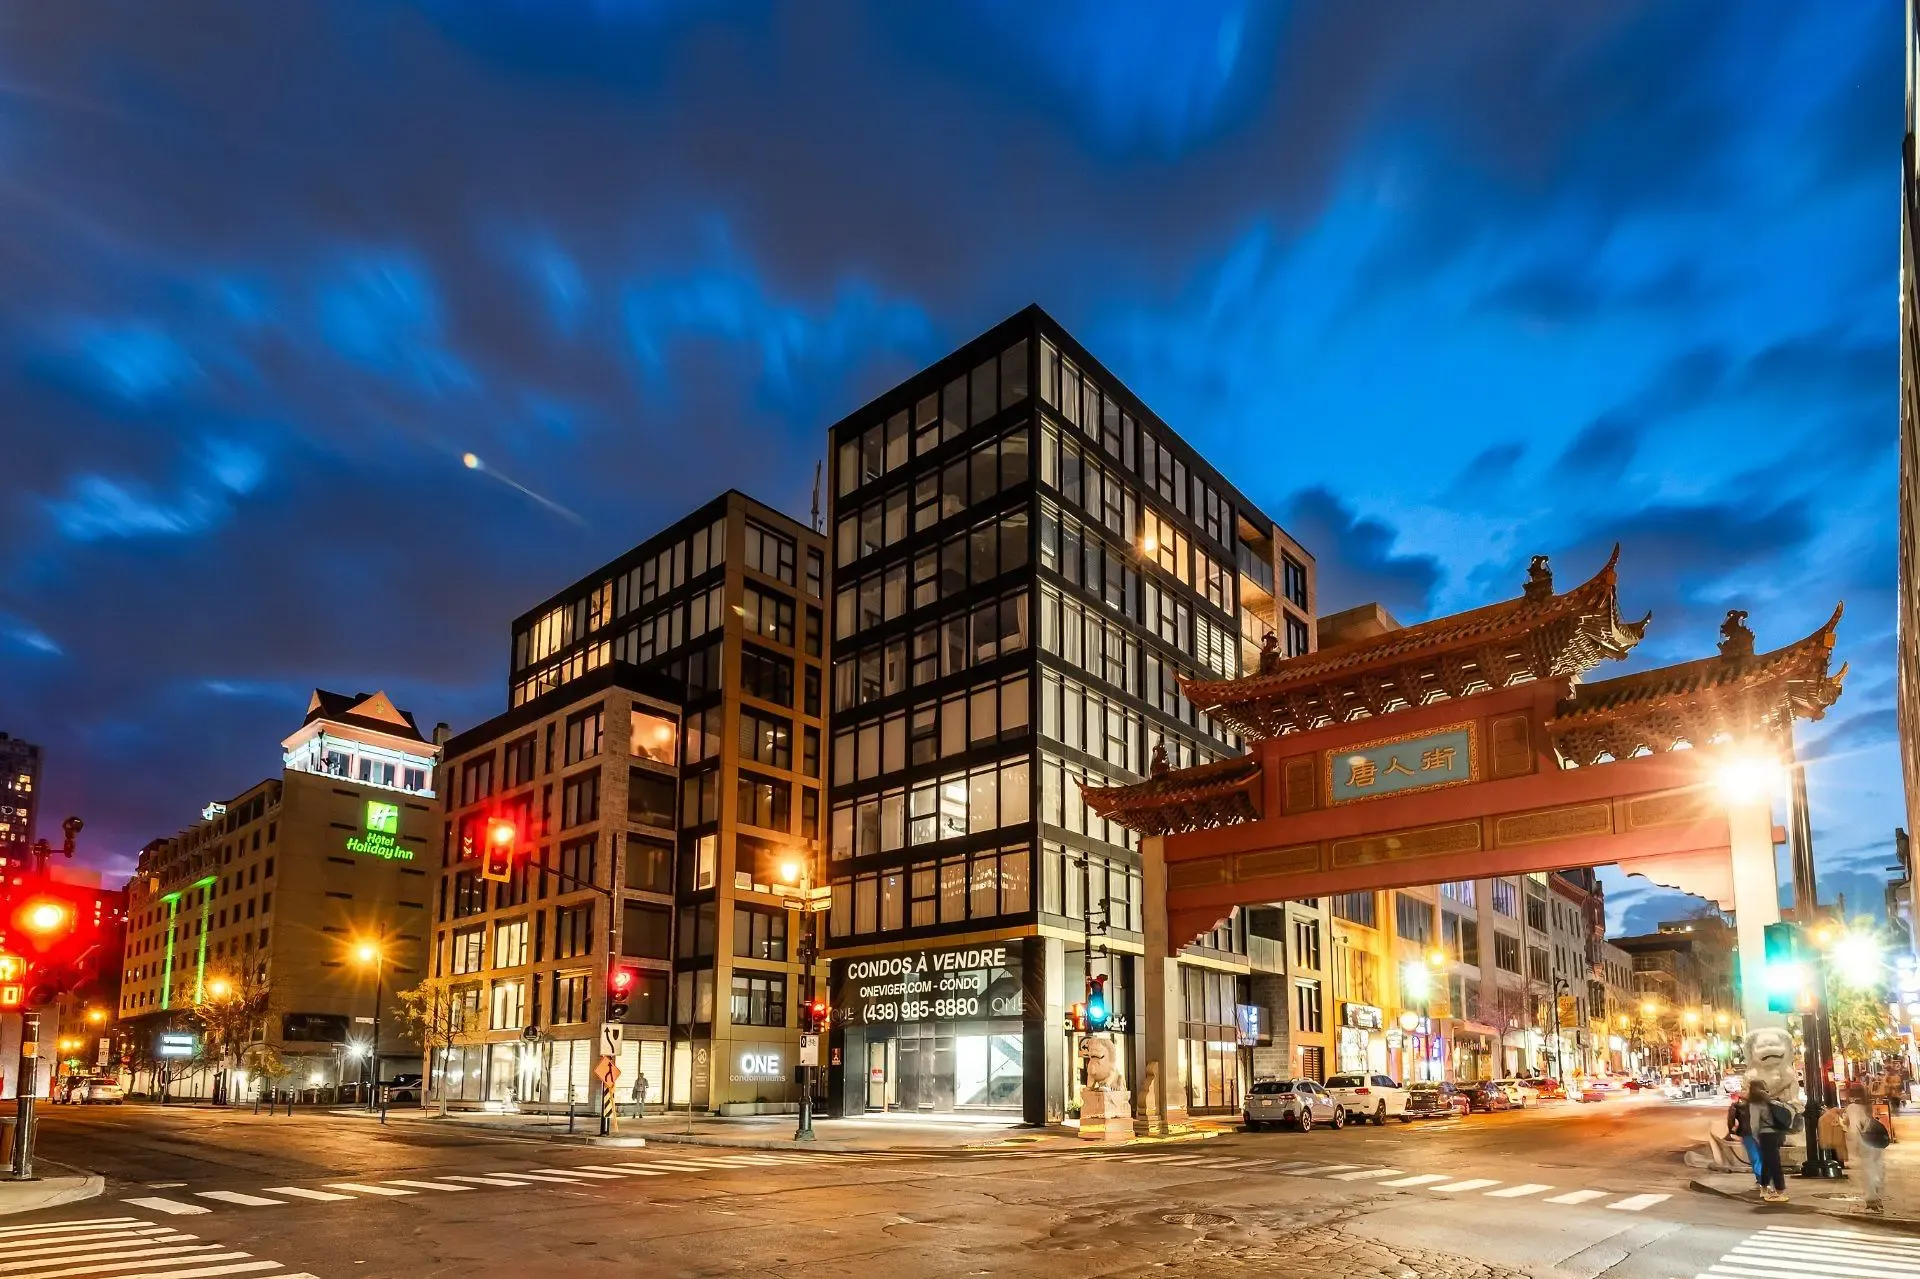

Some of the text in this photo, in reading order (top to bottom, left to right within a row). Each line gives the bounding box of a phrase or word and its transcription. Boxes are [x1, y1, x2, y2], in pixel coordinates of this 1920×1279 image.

[1346, 747, 1457, 788] 唐人街
[346, 837, 414, 860] Holiday Inn
[366, 832, 395, 847] Hôtel
[847, 947, 1006, 980] CONDOS À VENDRE
[859, 980, 932, 998] ONEVIGER.COM
[939, 976, 980, 991] CONDO
[862, 997, 979, 1024] (438) 985-8880
[740, 1054, 780, 1074] ONE
[729, 1073, 786, 1082] condominiums
